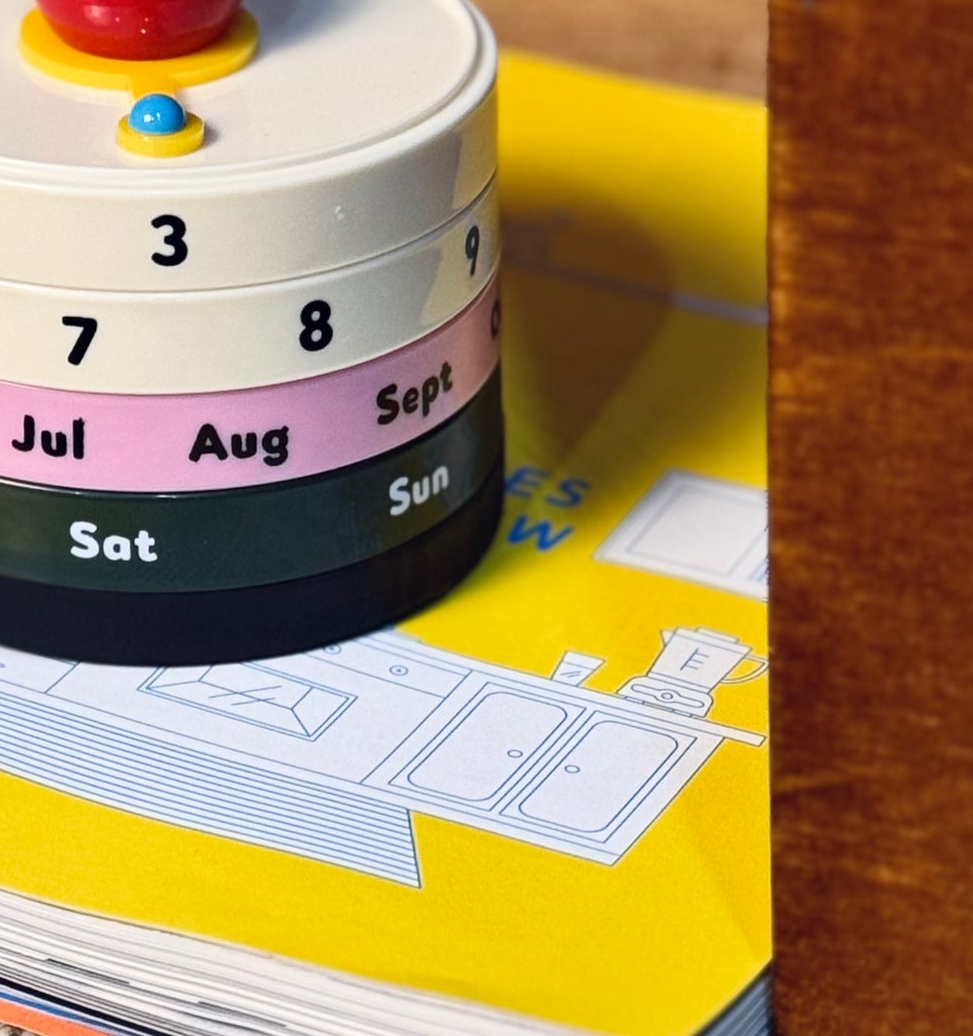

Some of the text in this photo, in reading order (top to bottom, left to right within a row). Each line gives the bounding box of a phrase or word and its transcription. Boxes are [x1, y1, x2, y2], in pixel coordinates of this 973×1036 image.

[150, 214, 189, 267] 3
[61, 316, 98, 366] 7
[298, 299, 334, 352] 8
[465, 224, 480, 277] 9
[11, 414, 86, 460] Jul
[188, 424, 290, 467] Aug
[376, 361, 454, 425] Sept
[69, 520, 158, 563] Sat
[388, 465, 449, 516] Sun
